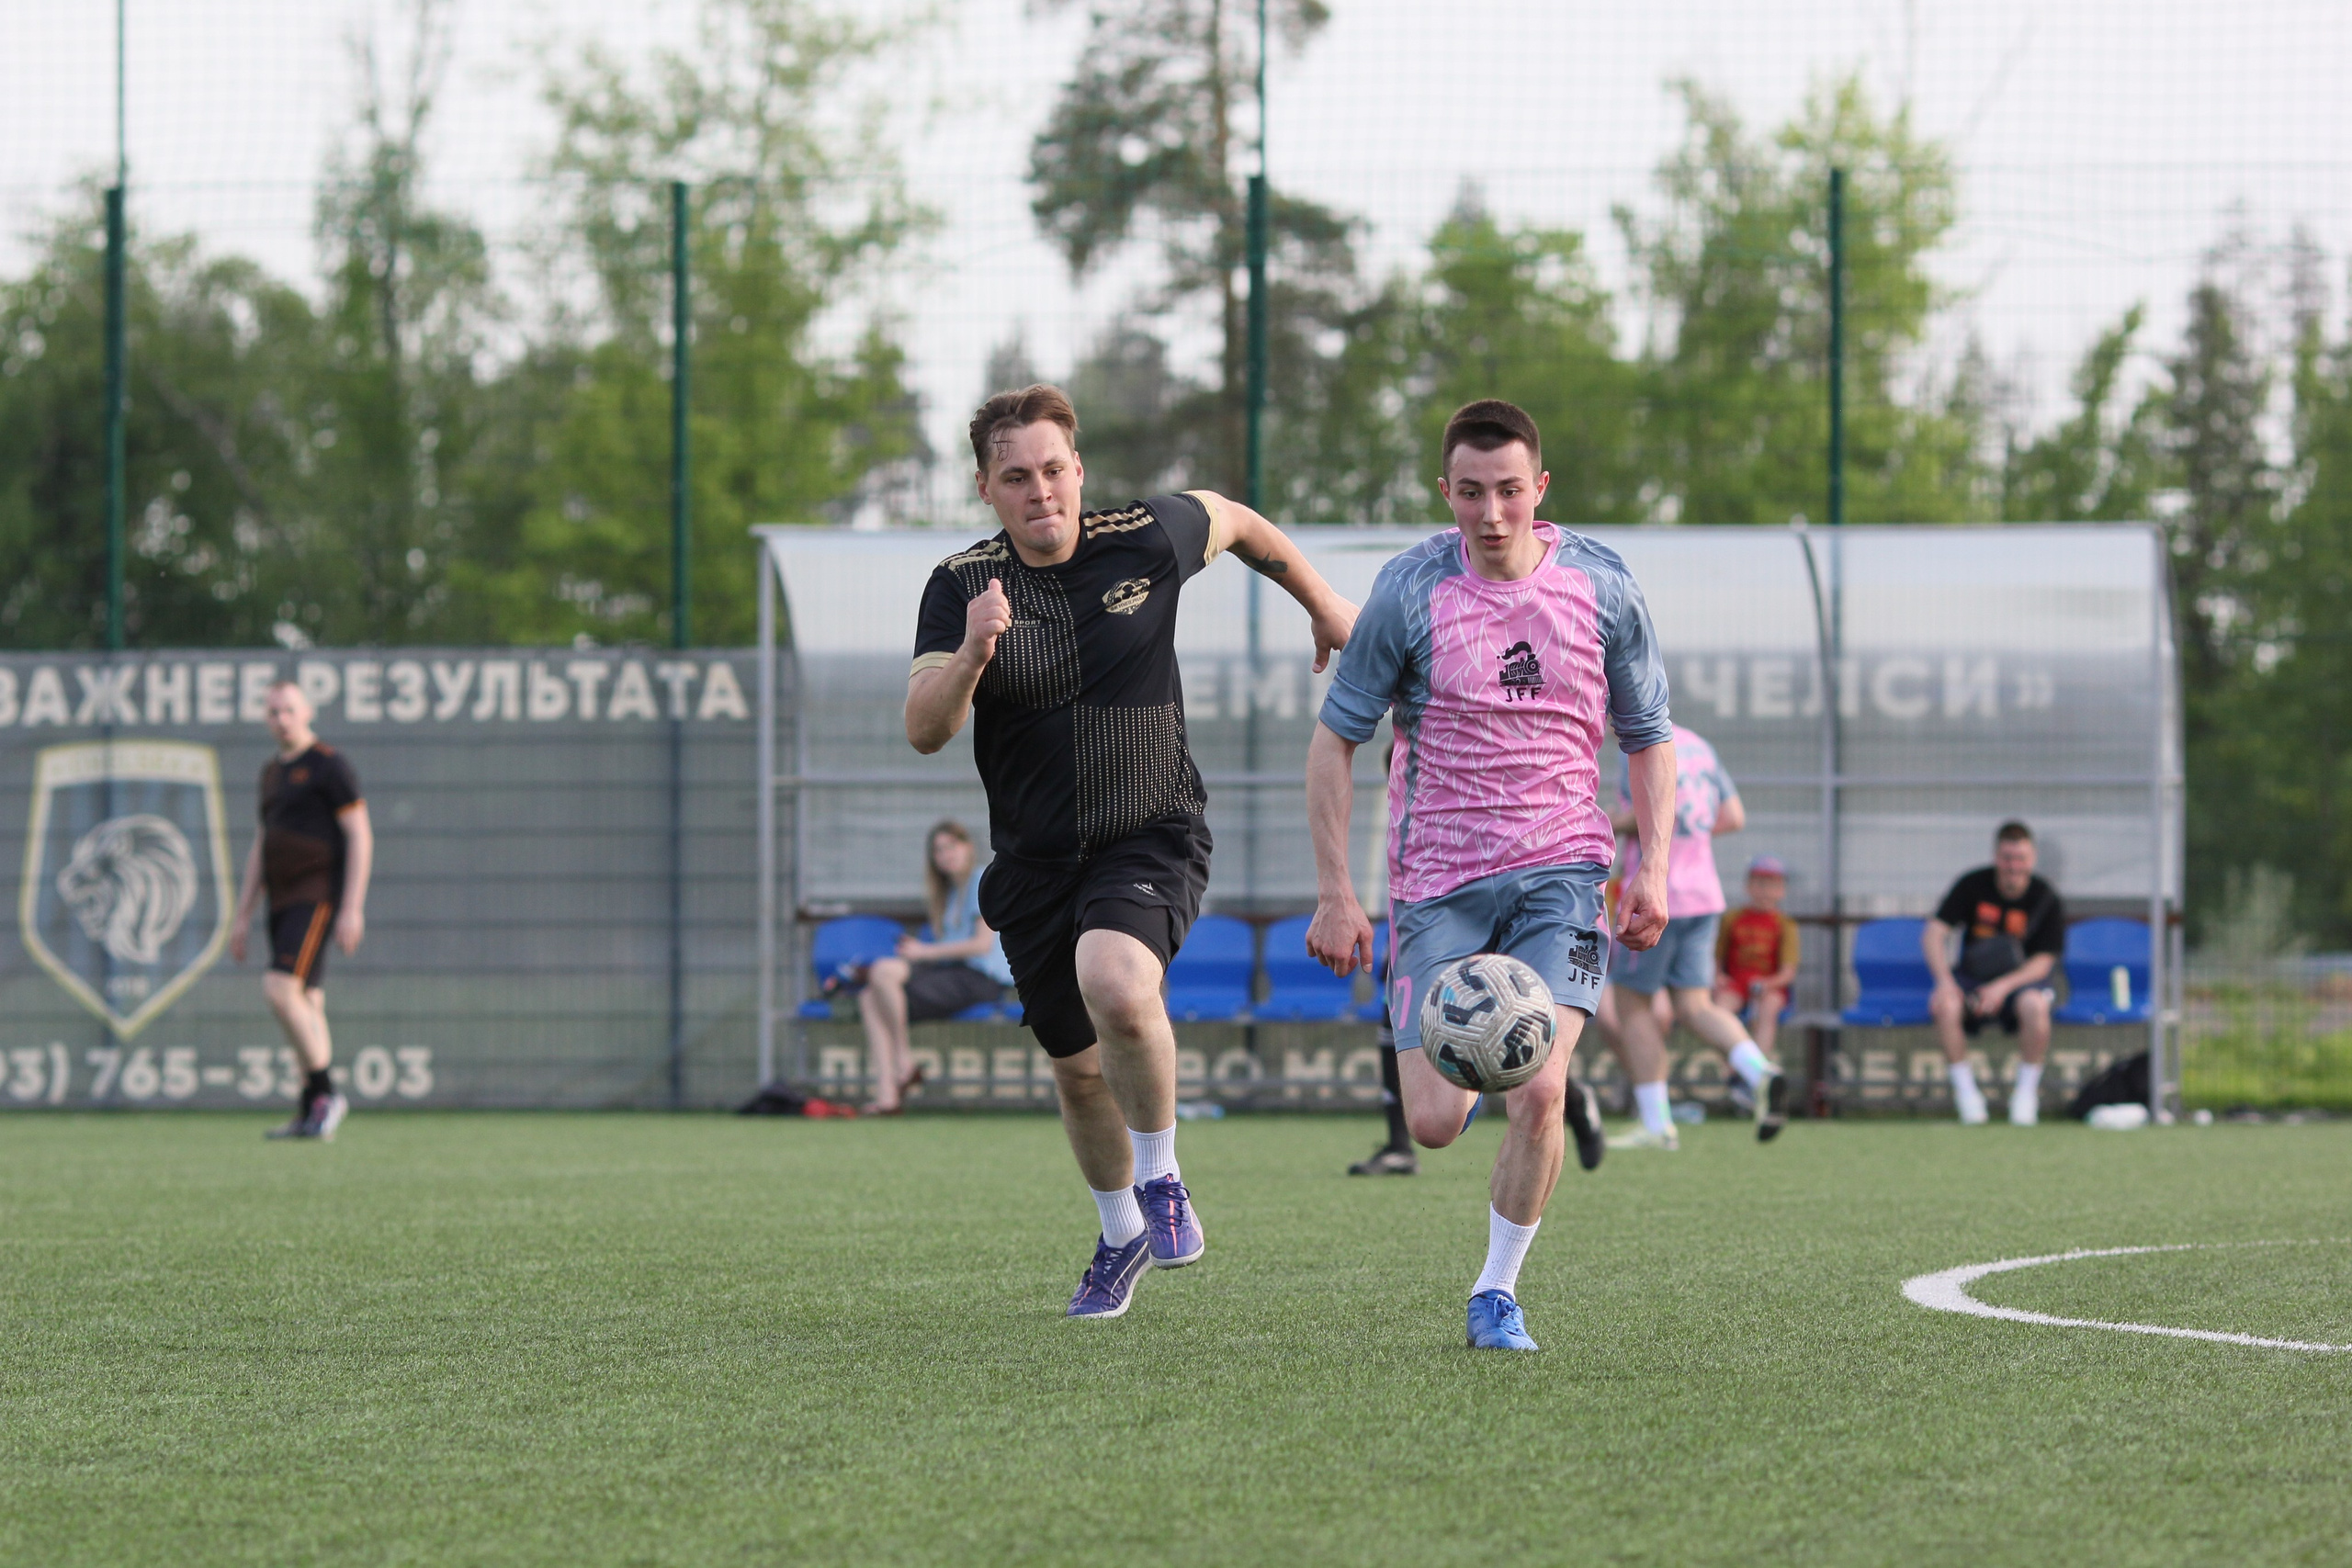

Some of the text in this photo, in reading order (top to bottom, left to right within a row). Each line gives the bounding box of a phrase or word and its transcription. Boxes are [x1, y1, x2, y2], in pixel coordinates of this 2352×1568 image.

[297, 660, 749, 722] РЕЗУЛЬТАТА
[1505, 686, 1542, 703] JFF
[1567, 967, 1600, 989] JFF
[0, 1043, 71, 1105] 3)
